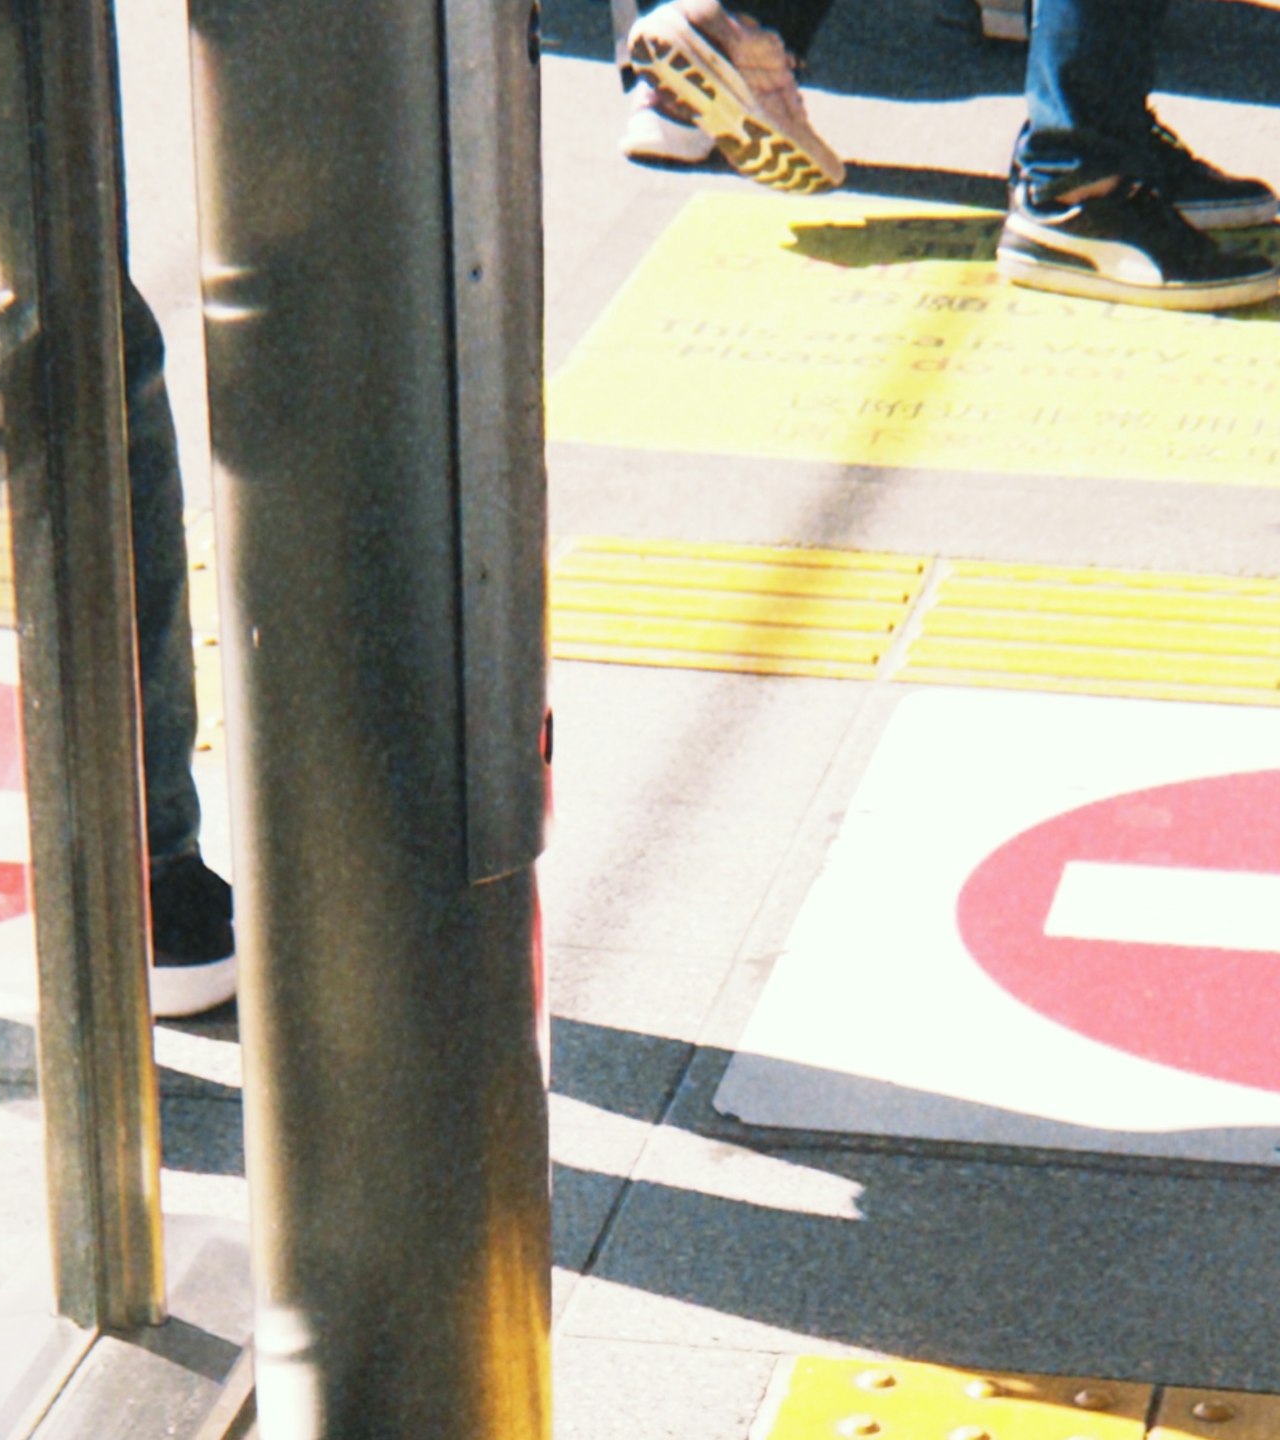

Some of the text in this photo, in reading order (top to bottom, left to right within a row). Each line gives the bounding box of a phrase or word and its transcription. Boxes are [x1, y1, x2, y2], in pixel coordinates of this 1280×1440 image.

[658, 318, 785, 340] This
[803, 328, 948, 348] area
[969, 337, 1020, 353] is
[1039, 341, 1187, 365] very
[676, 342, 889, 369] Please
[909, 355, 996, 374] do
[1019, 363, 1130, 382] not
